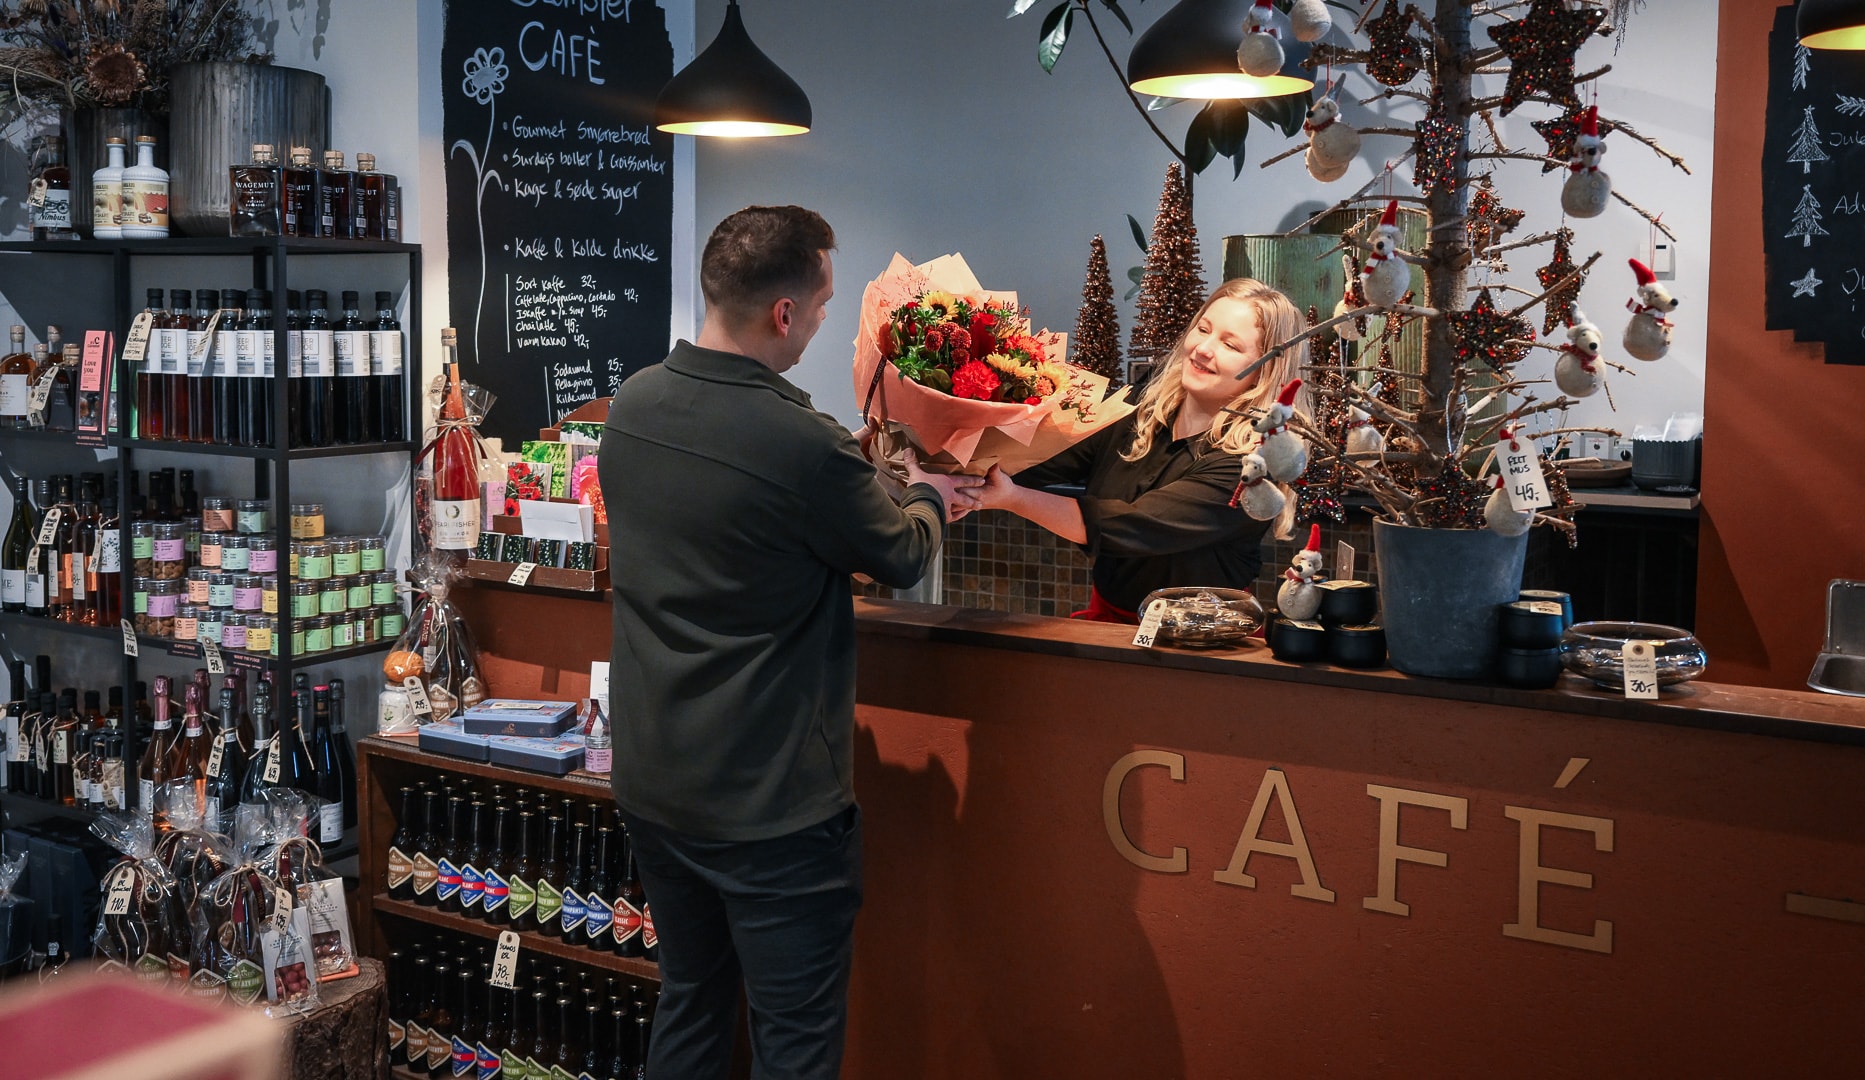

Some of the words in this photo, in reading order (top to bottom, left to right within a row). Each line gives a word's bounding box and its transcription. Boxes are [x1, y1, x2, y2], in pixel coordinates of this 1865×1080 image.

[512, 115, 566, 139] Gourmet
[577, 121, 651, 146] Smørrebrød
[512, 148, 555, 173] Surdejs
[235, 181, 275, 189] WAGEMUT
[514, 178, 549, 208] Kage
[566, 179, 598, 201] søde
[602, 181, 642, 215] sager
[39, 212, 66, 222] Nimbus
[515, 237, 549, 261] Kaffe
[515, 275, 538, 291] Sort
[84, 359, 97, 367] Love
[553, 359, 593, 377] Sodavand
[555, 378, 593, 393] Pellegrino
[556, 387, 597, 404] Kildevand
[1510, 464, 1530, 476] MUS
[1102, 749, 1614, 953] CAFÉ
